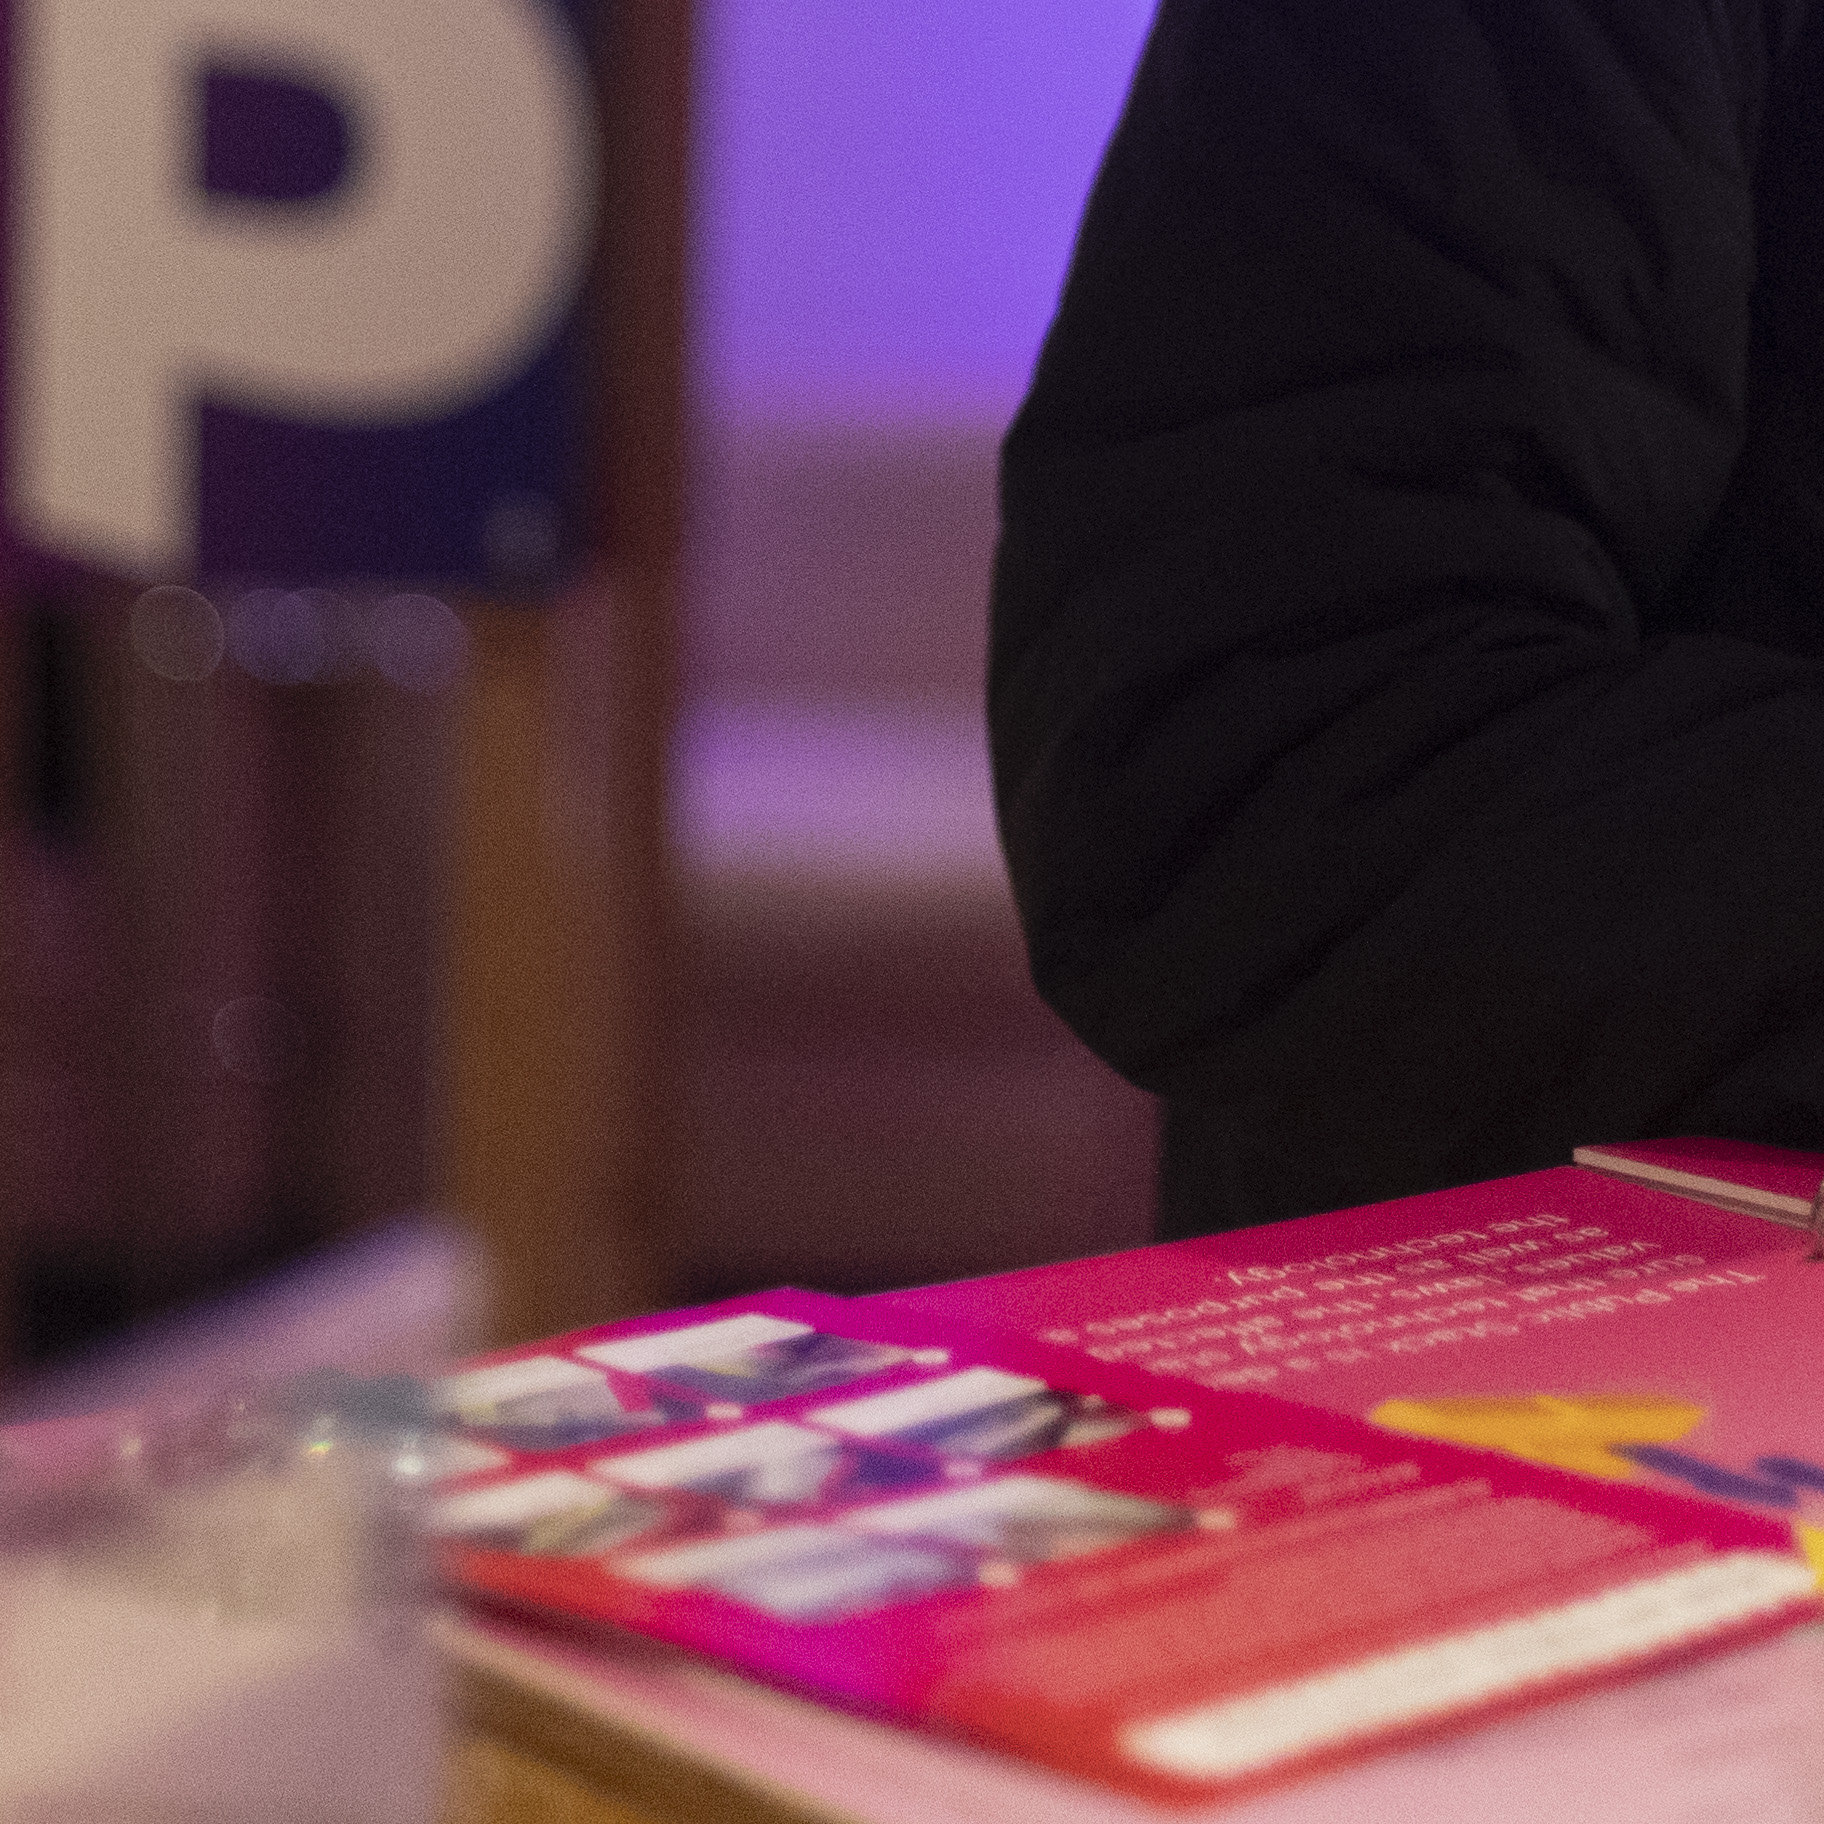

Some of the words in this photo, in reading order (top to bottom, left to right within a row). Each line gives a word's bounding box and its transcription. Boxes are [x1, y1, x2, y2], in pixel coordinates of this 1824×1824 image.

[1487, 1213, 1570, 1233] the
[1456, 1239, 1542, 1263] well
[1666, 1270, 1764, 1293] The
[1239, 1297, 1509, 1354] technology
